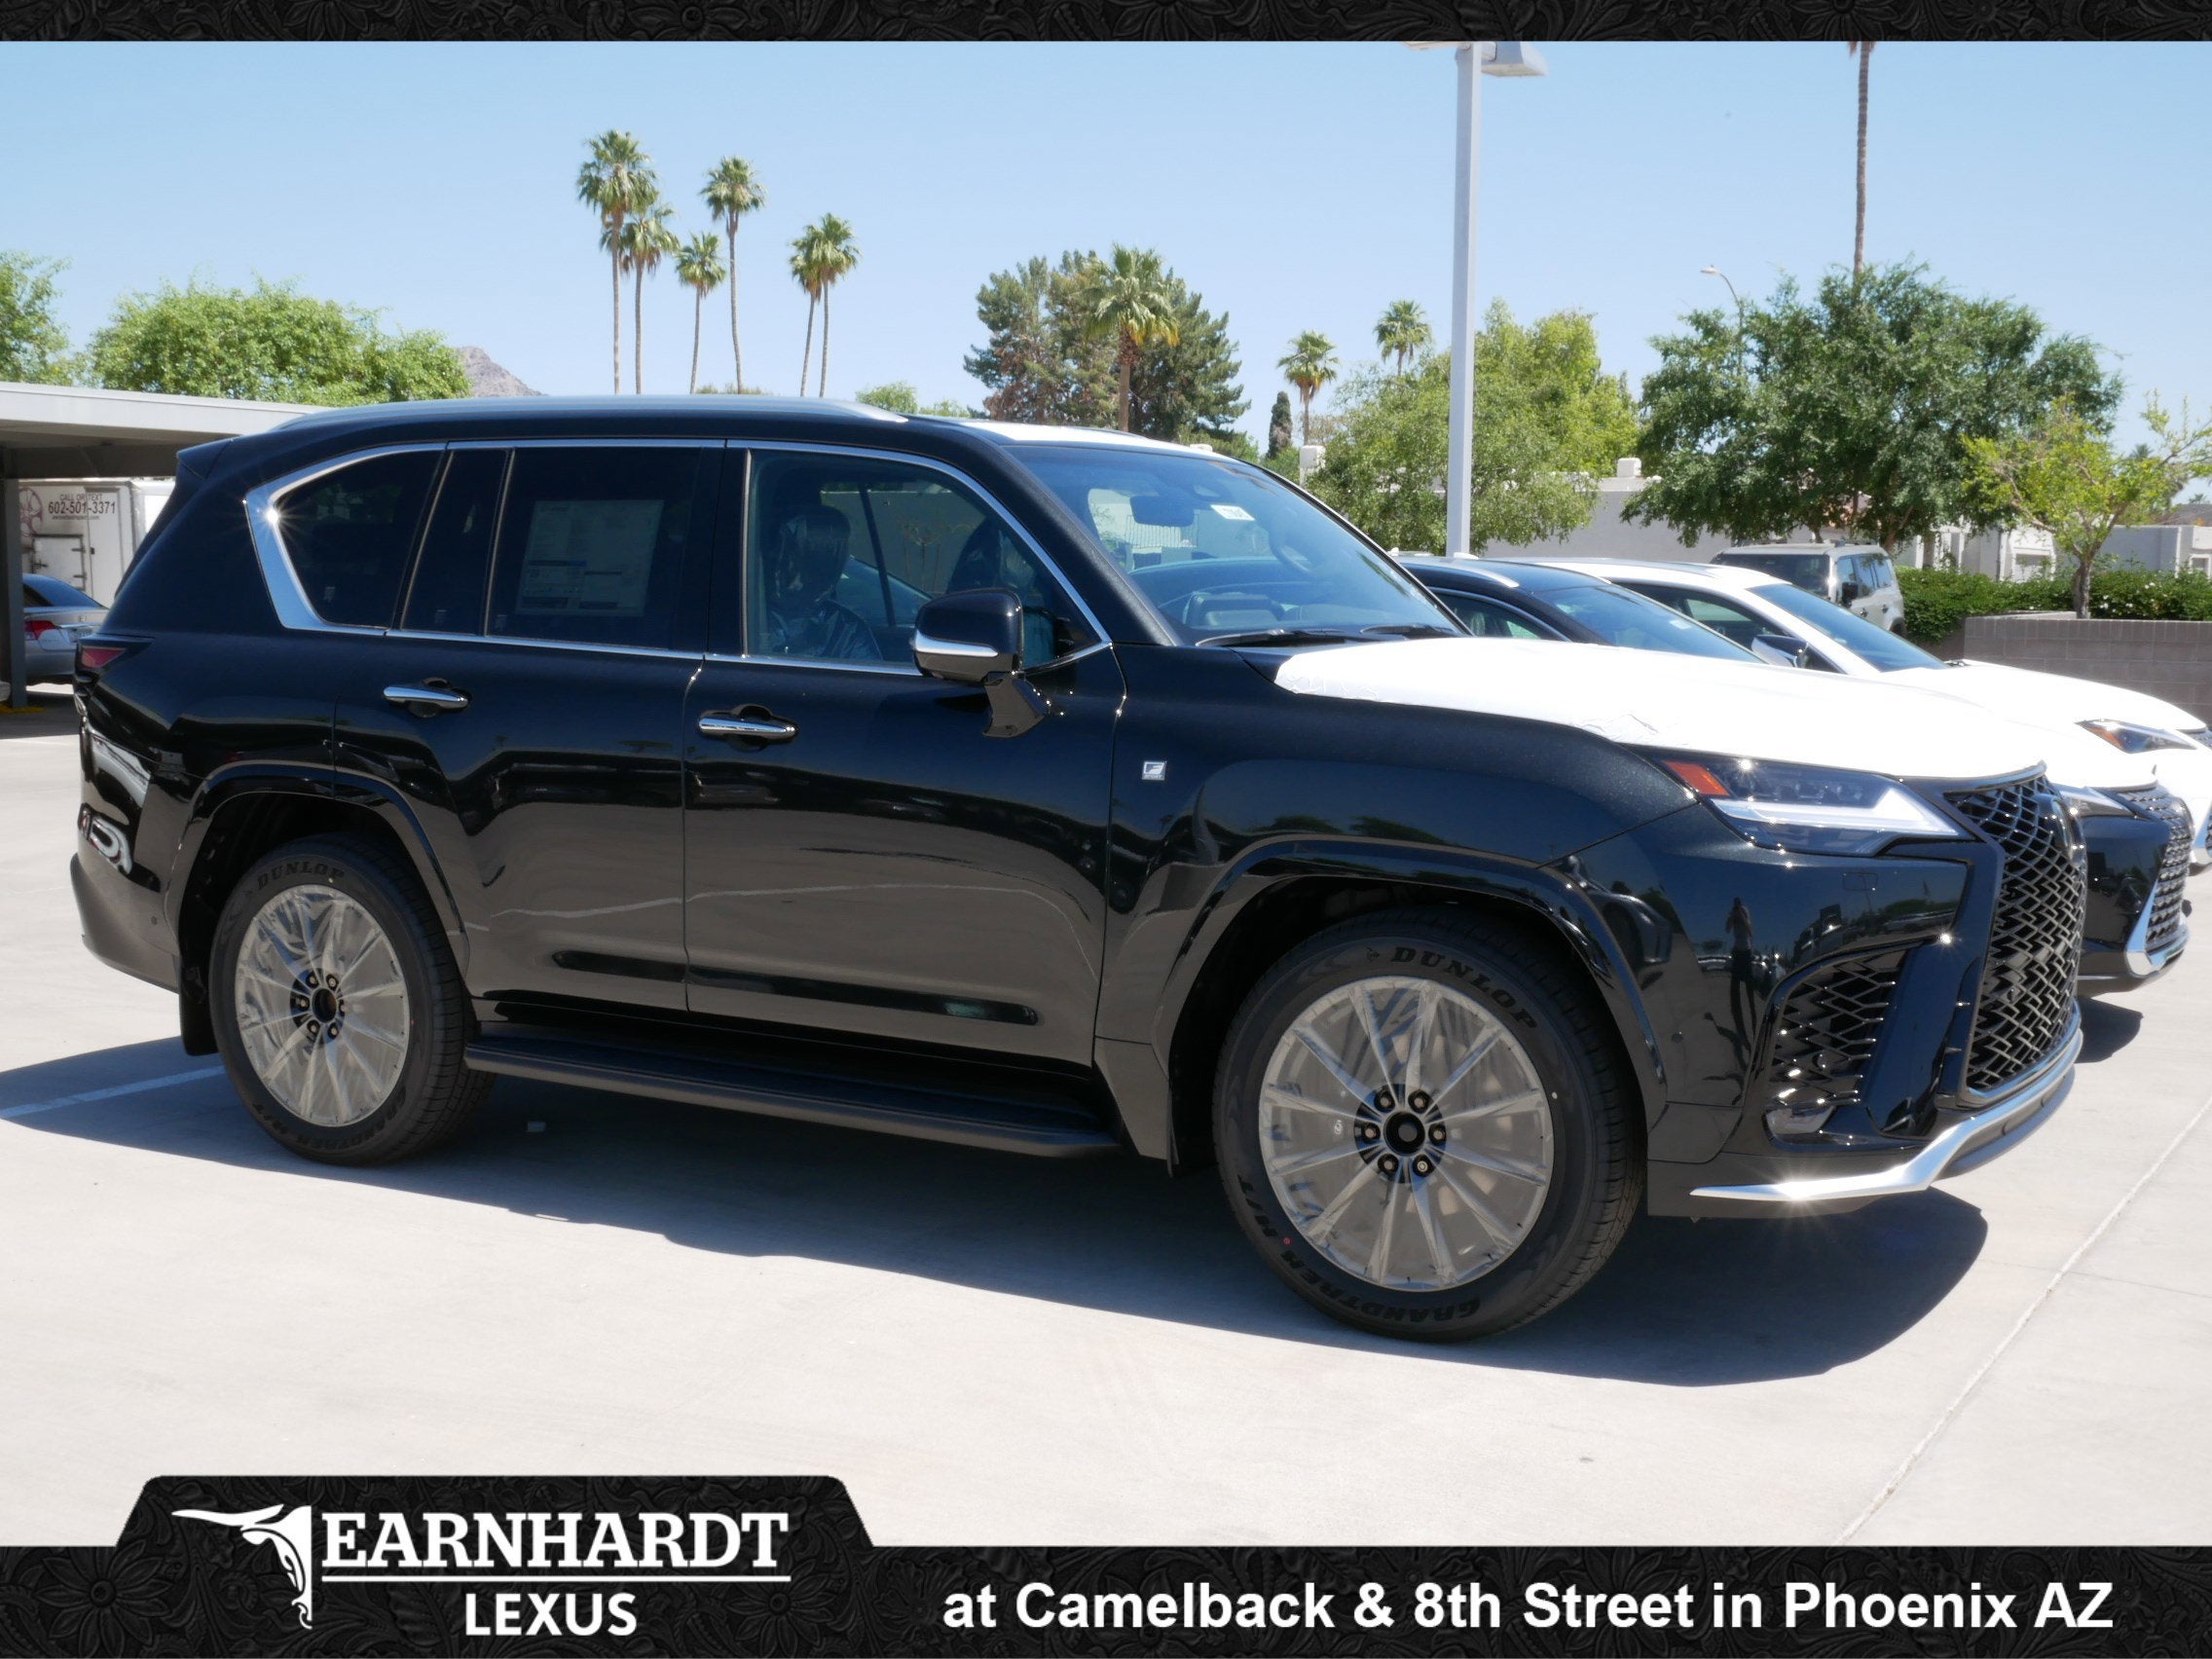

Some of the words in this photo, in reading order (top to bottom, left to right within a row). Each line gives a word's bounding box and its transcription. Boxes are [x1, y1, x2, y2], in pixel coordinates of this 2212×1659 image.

[48, 501, 115, 514] 602-501-3371
[258, 862, 345, 890] DUNLOP
[1391, 946, 1538, 1029] DUNLOP
[1281, 1250, 1481, 1323] GRANDTREK
